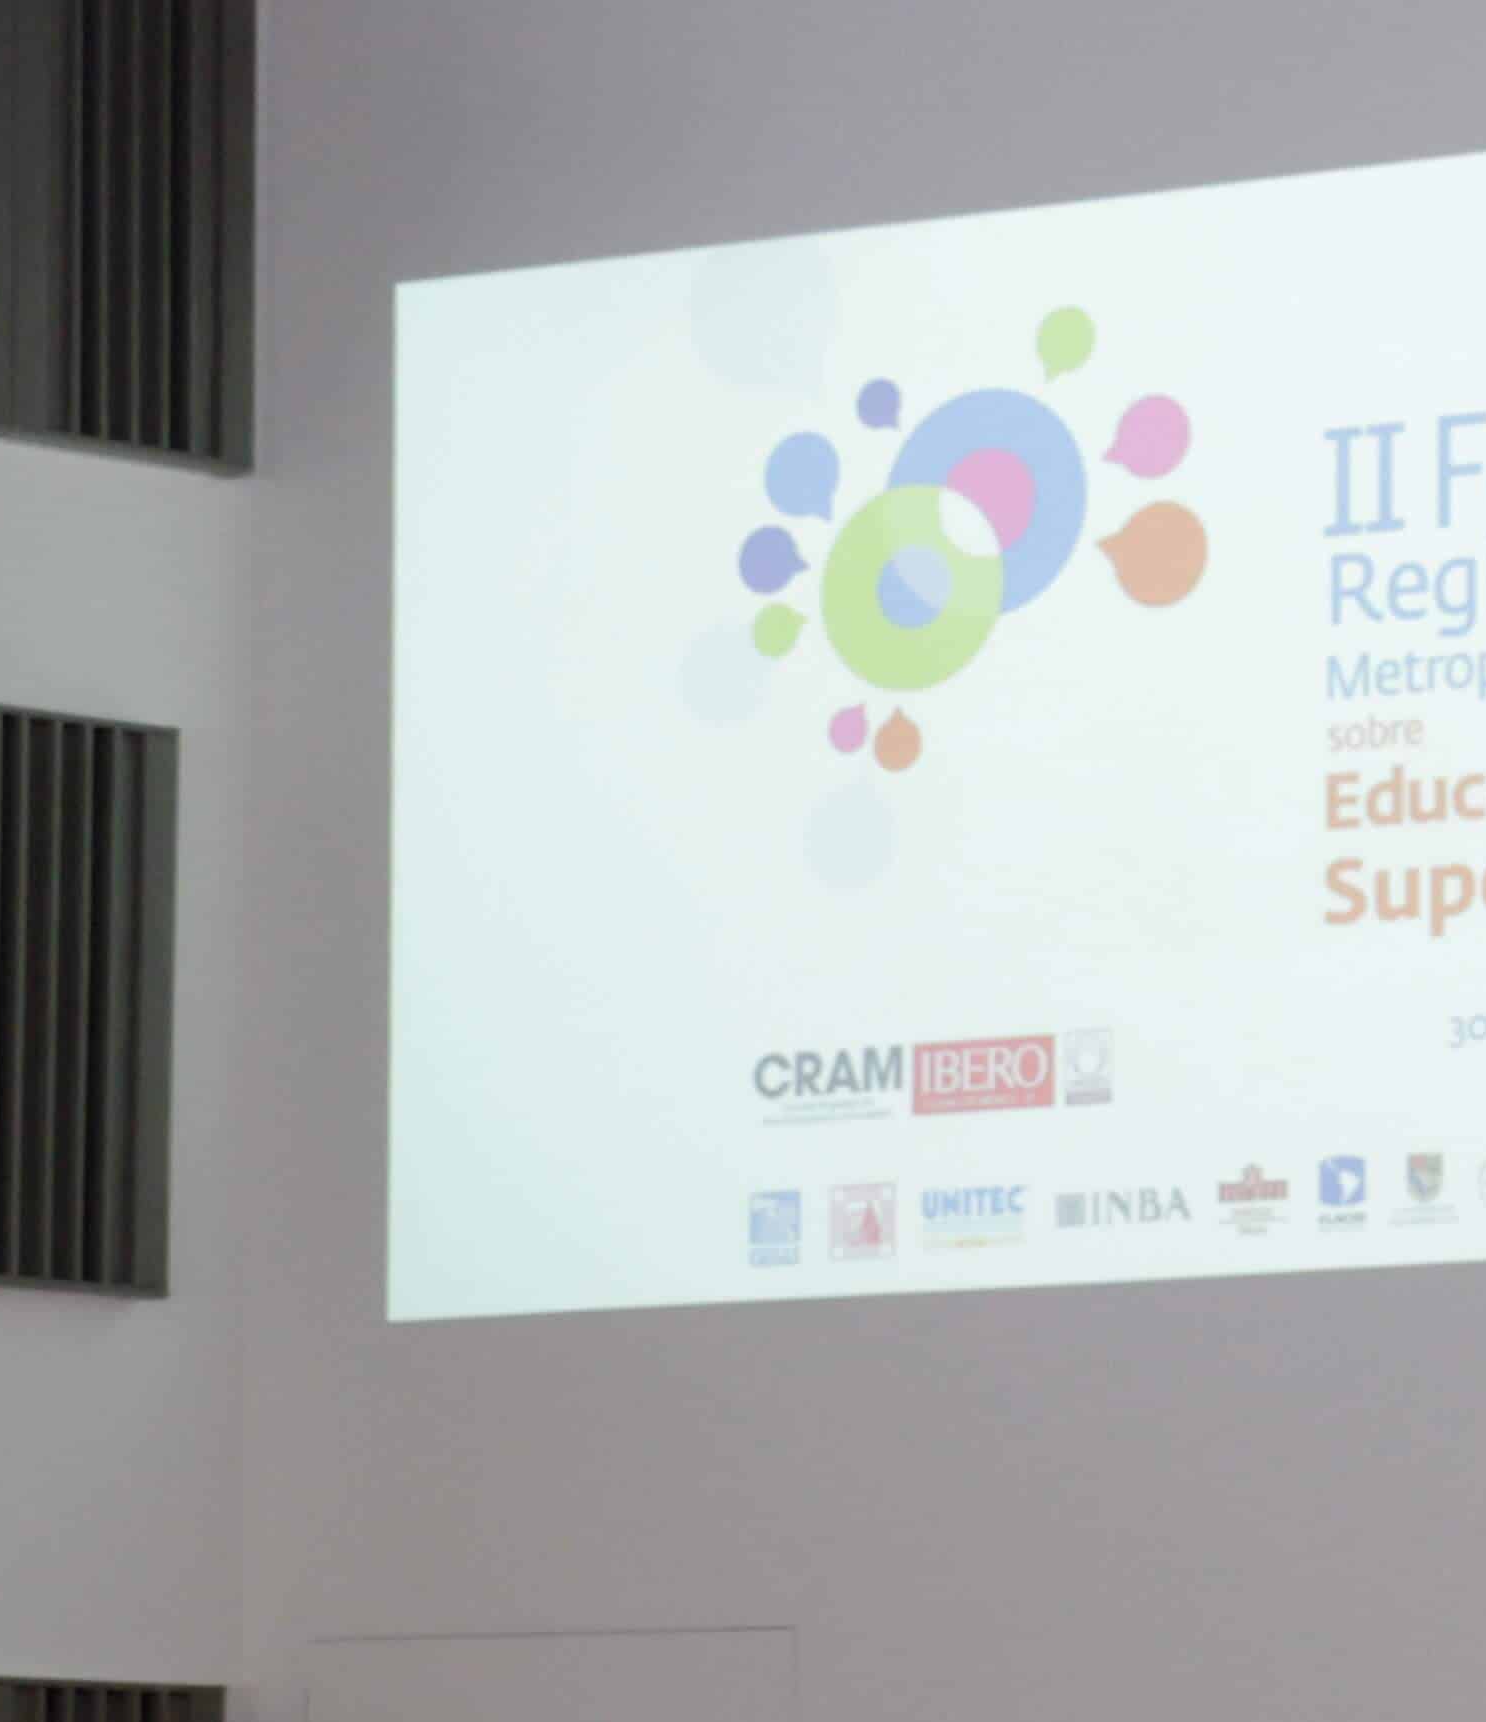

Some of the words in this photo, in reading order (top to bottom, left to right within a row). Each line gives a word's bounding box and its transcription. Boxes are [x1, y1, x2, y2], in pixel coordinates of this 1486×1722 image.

[1323, 420, 1407, 538] II
[1326, 714, 1425, 754] sobre
[752, 1043, 904, 1101] CRAM
[919, 1043, 1049, 1094] IBERO
[920, 1184, 1026, 1220] UNITEC
